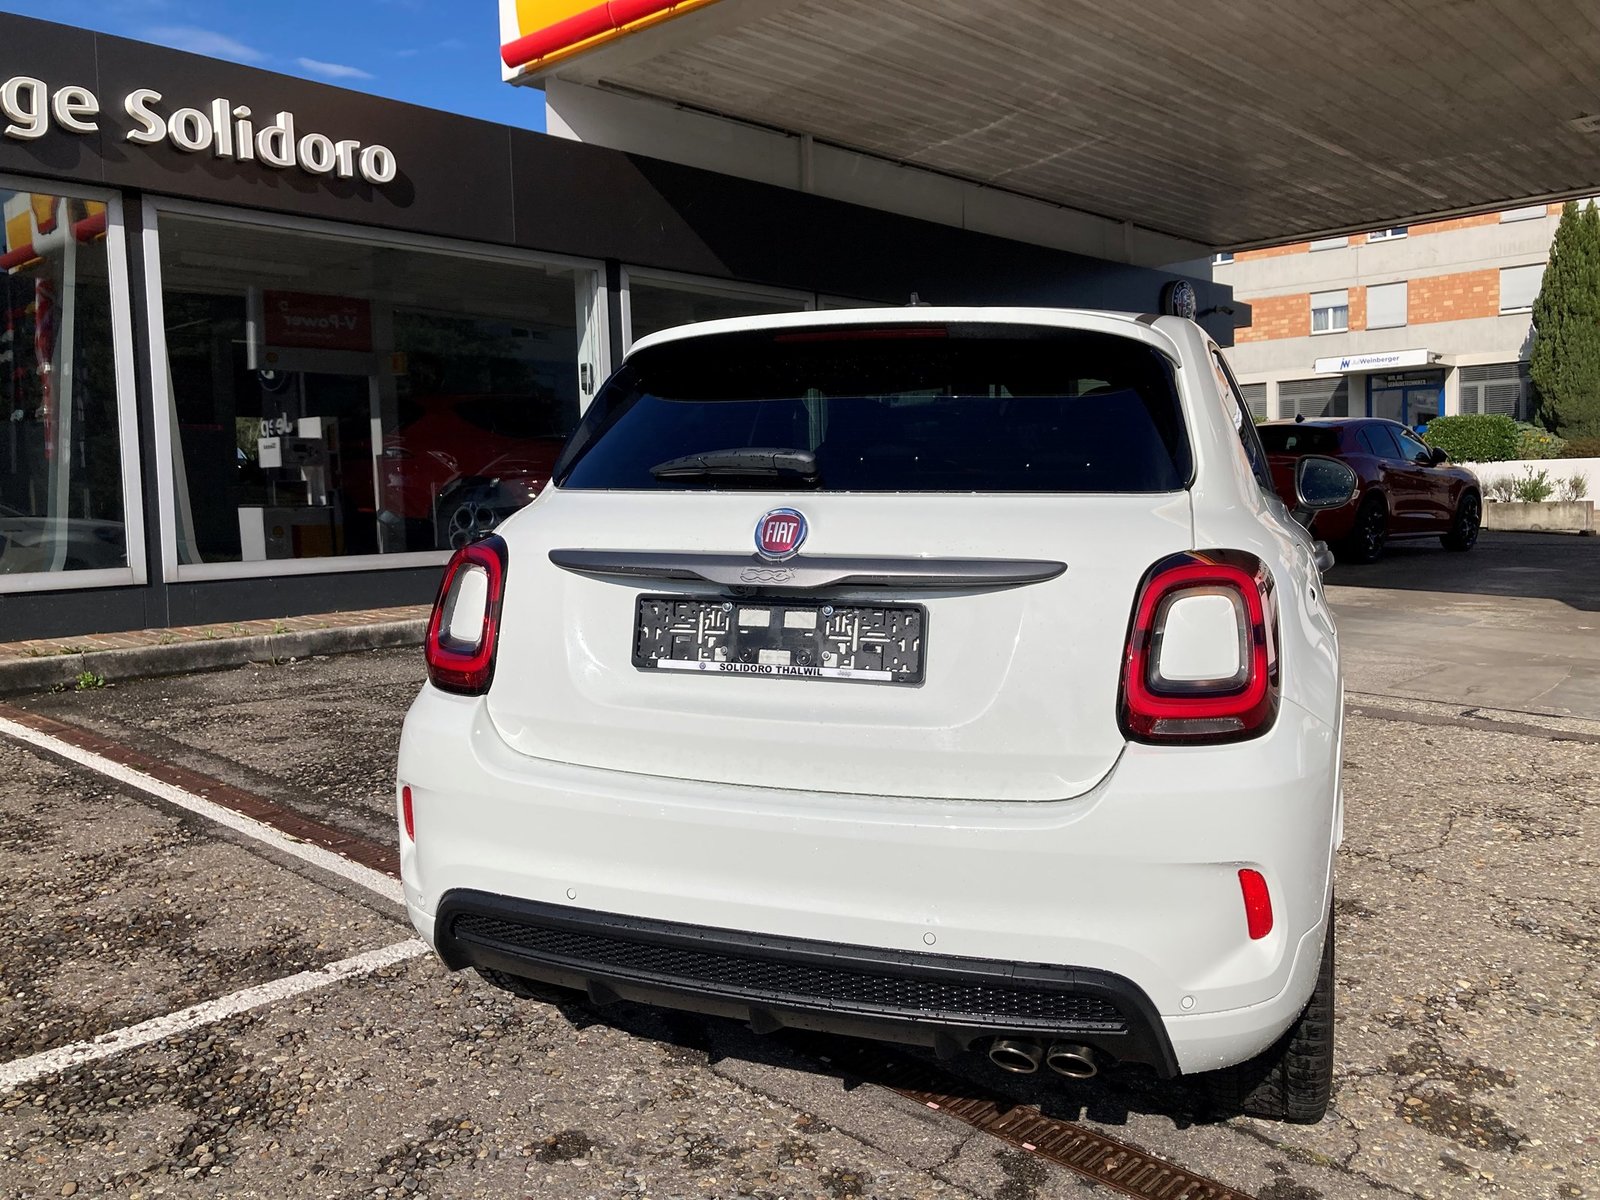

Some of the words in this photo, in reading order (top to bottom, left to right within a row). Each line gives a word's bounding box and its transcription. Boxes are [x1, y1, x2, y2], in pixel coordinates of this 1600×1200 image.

[124, 88, 397, 184] Solidoro
[765, 521, 797, 543] FIAT
[719, 662, 773, 674] SOLIDORO
[775, 665, 823, 677] THALWIL
